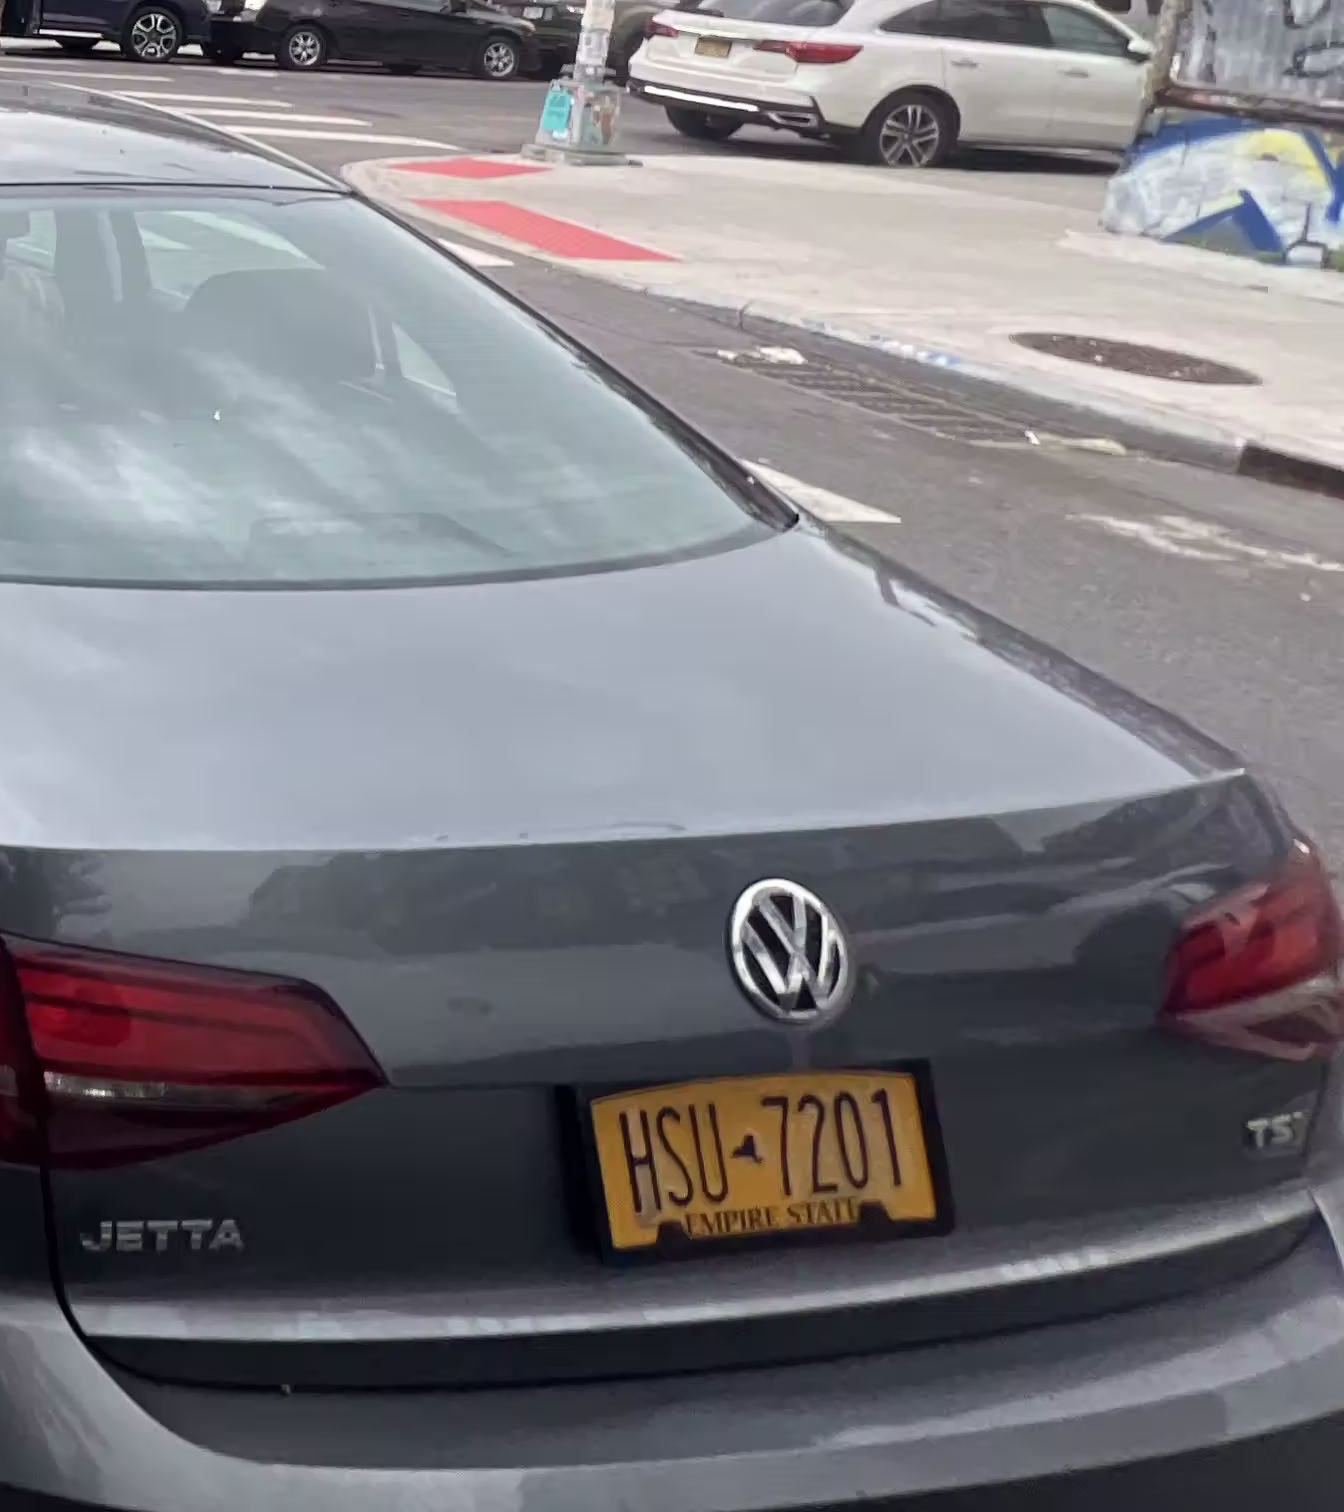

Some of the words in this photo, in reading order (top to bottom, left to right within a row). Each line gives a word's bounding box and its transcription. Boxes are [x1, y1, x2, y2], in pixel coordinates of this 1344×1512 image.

[619, 1102, 730, 1214] HSU
[761, 1089, 902, 1196] 7201
[80, 1219, 244, 1252] JETTA
[685, 1206, 775, 1236] EMPIRE
